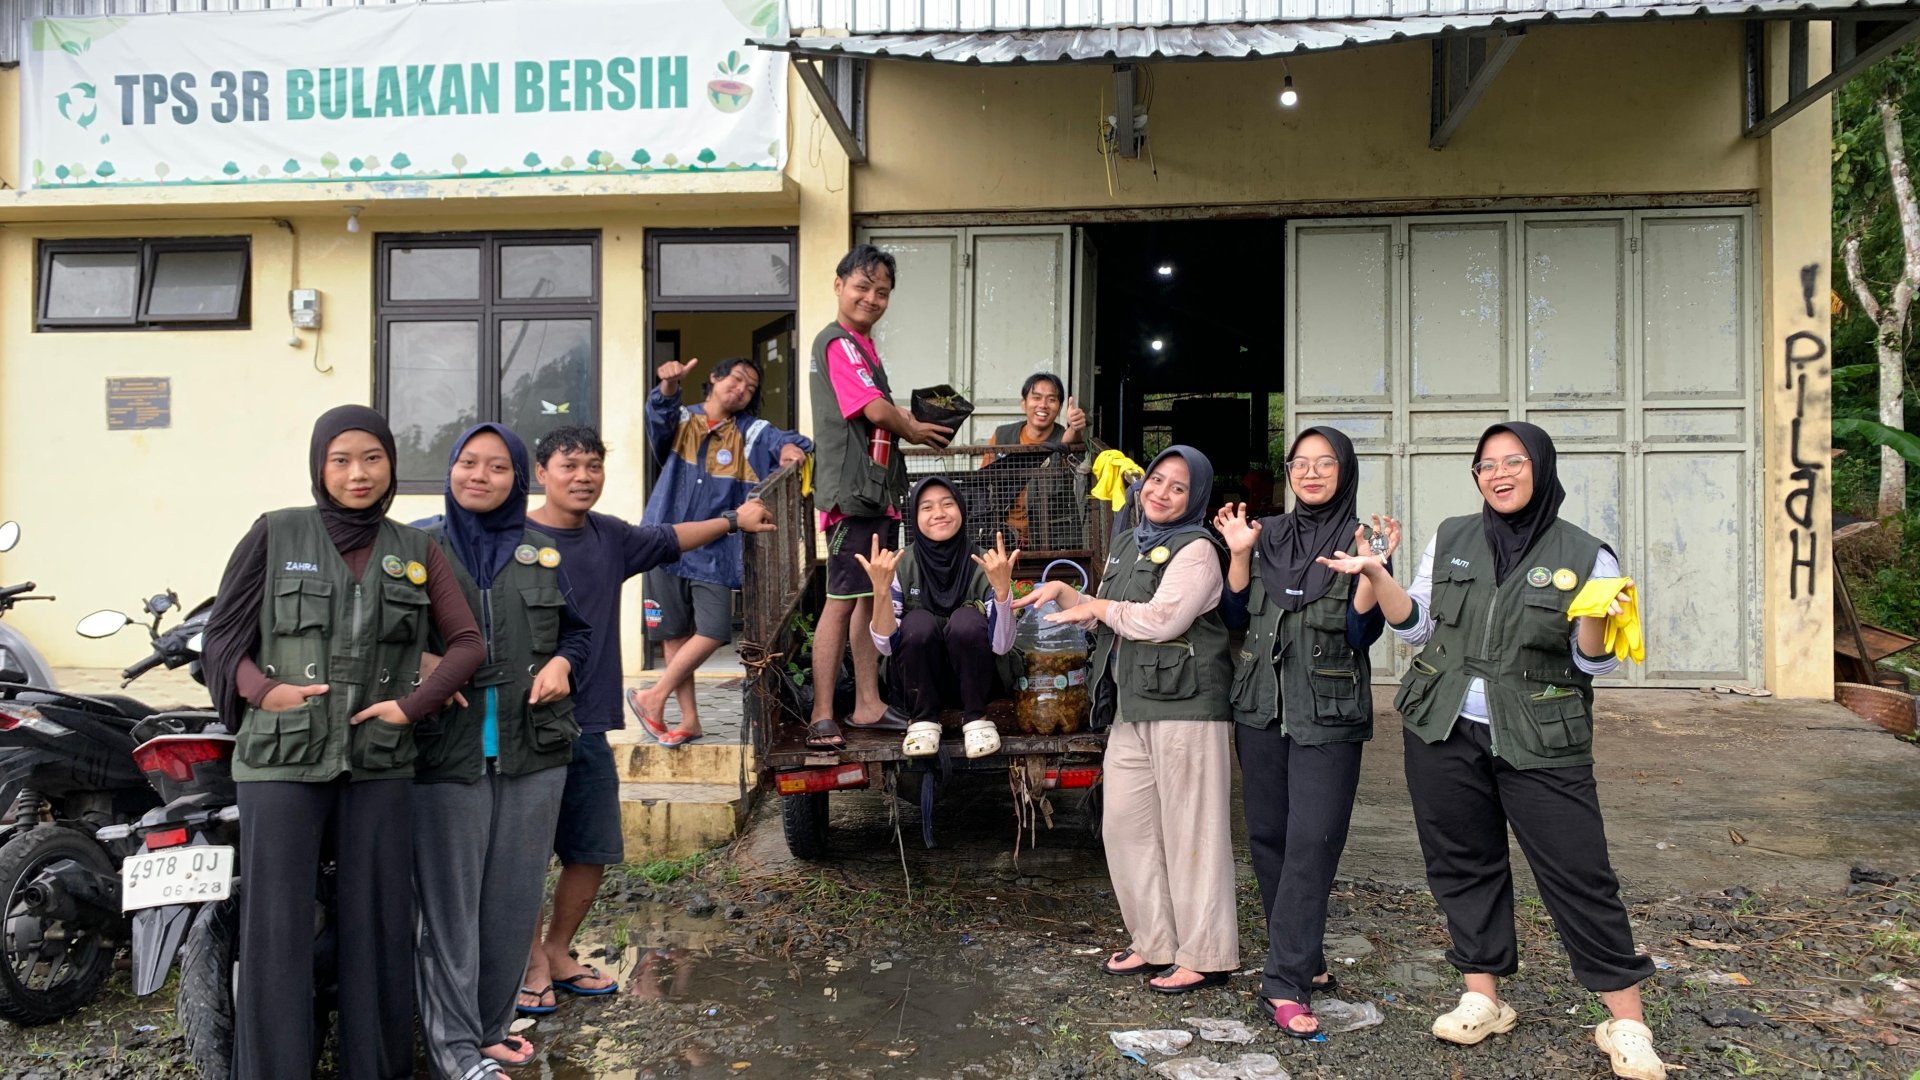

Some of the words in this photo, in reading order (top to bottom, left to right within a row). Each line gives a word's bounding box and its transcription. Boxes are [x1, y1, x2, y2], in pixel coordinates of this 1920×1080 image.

[114, 72, 198, 126] TPS
[210, 70, 270, 124] 3R
[286, 62, 499, 120] BULAKAN
[514, 55, 688, 113] BERSIH
[285, 561, 319, 573] ZAHRA
[1450, 557, 1470, 568] MUTI
[130, 856, 178, 881] 4978
